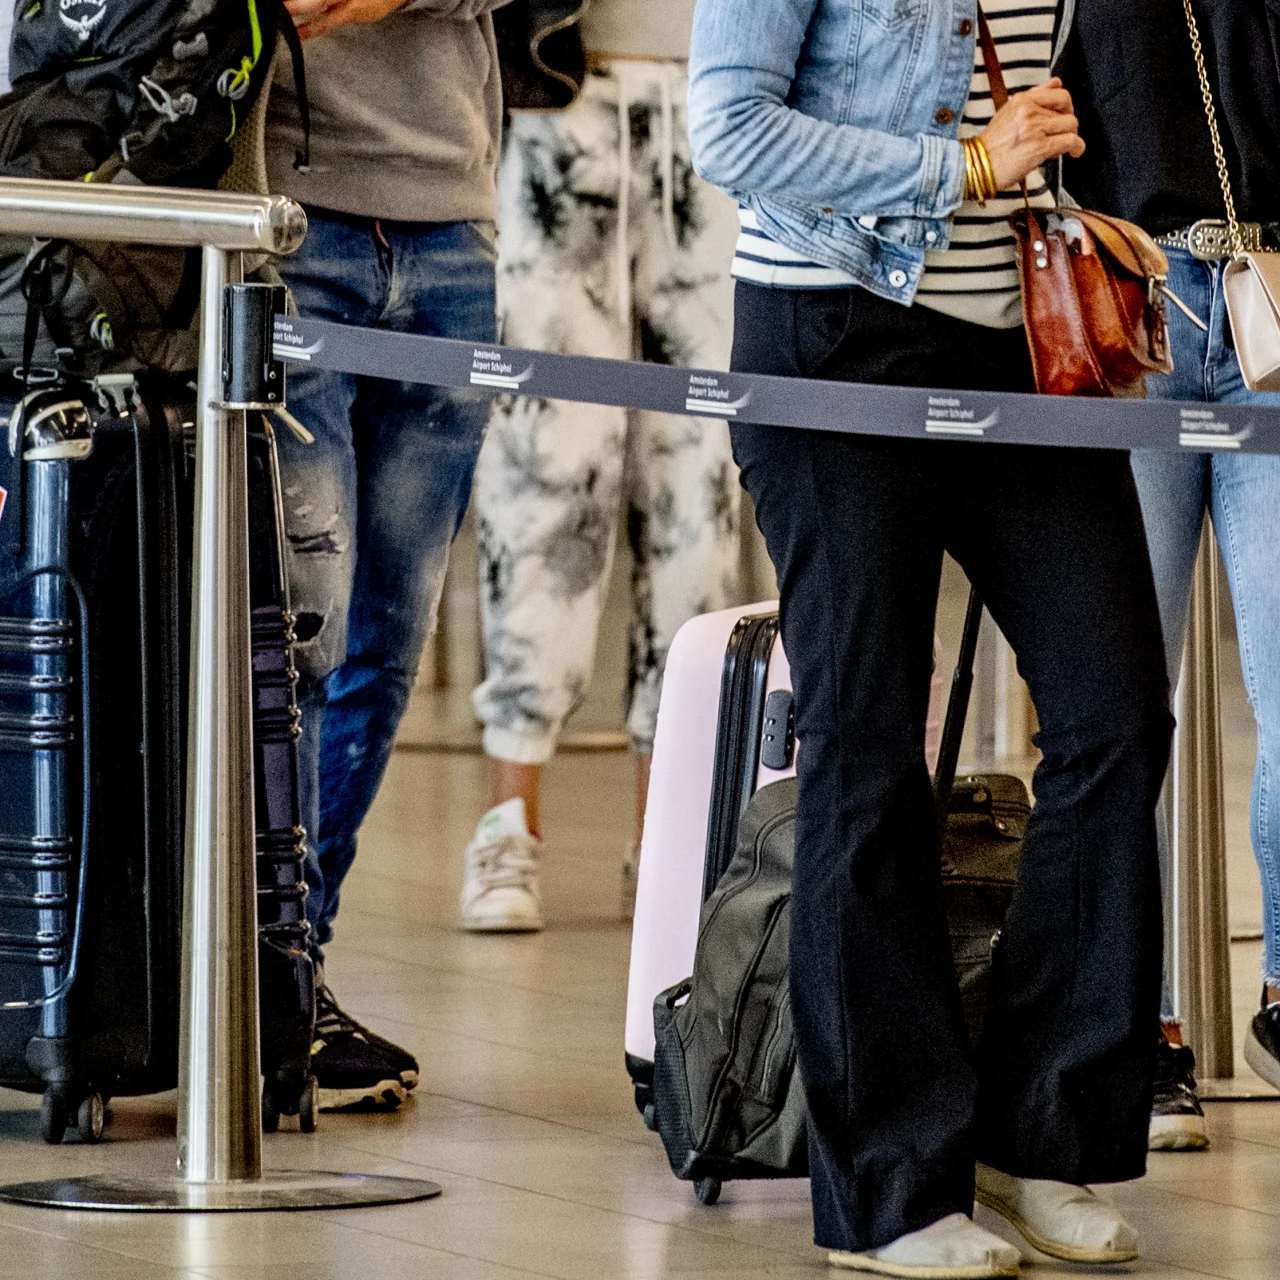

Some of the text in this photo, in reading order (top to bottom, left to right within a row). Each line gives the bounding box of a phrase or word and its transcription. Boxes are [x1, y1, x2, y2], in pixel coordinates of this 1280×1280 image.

[473, 348, 501, 361] Amsterdam
[472, 359, 512, 374] Airport Schiphol
[689, 374, 718, 387] Amsterdam
